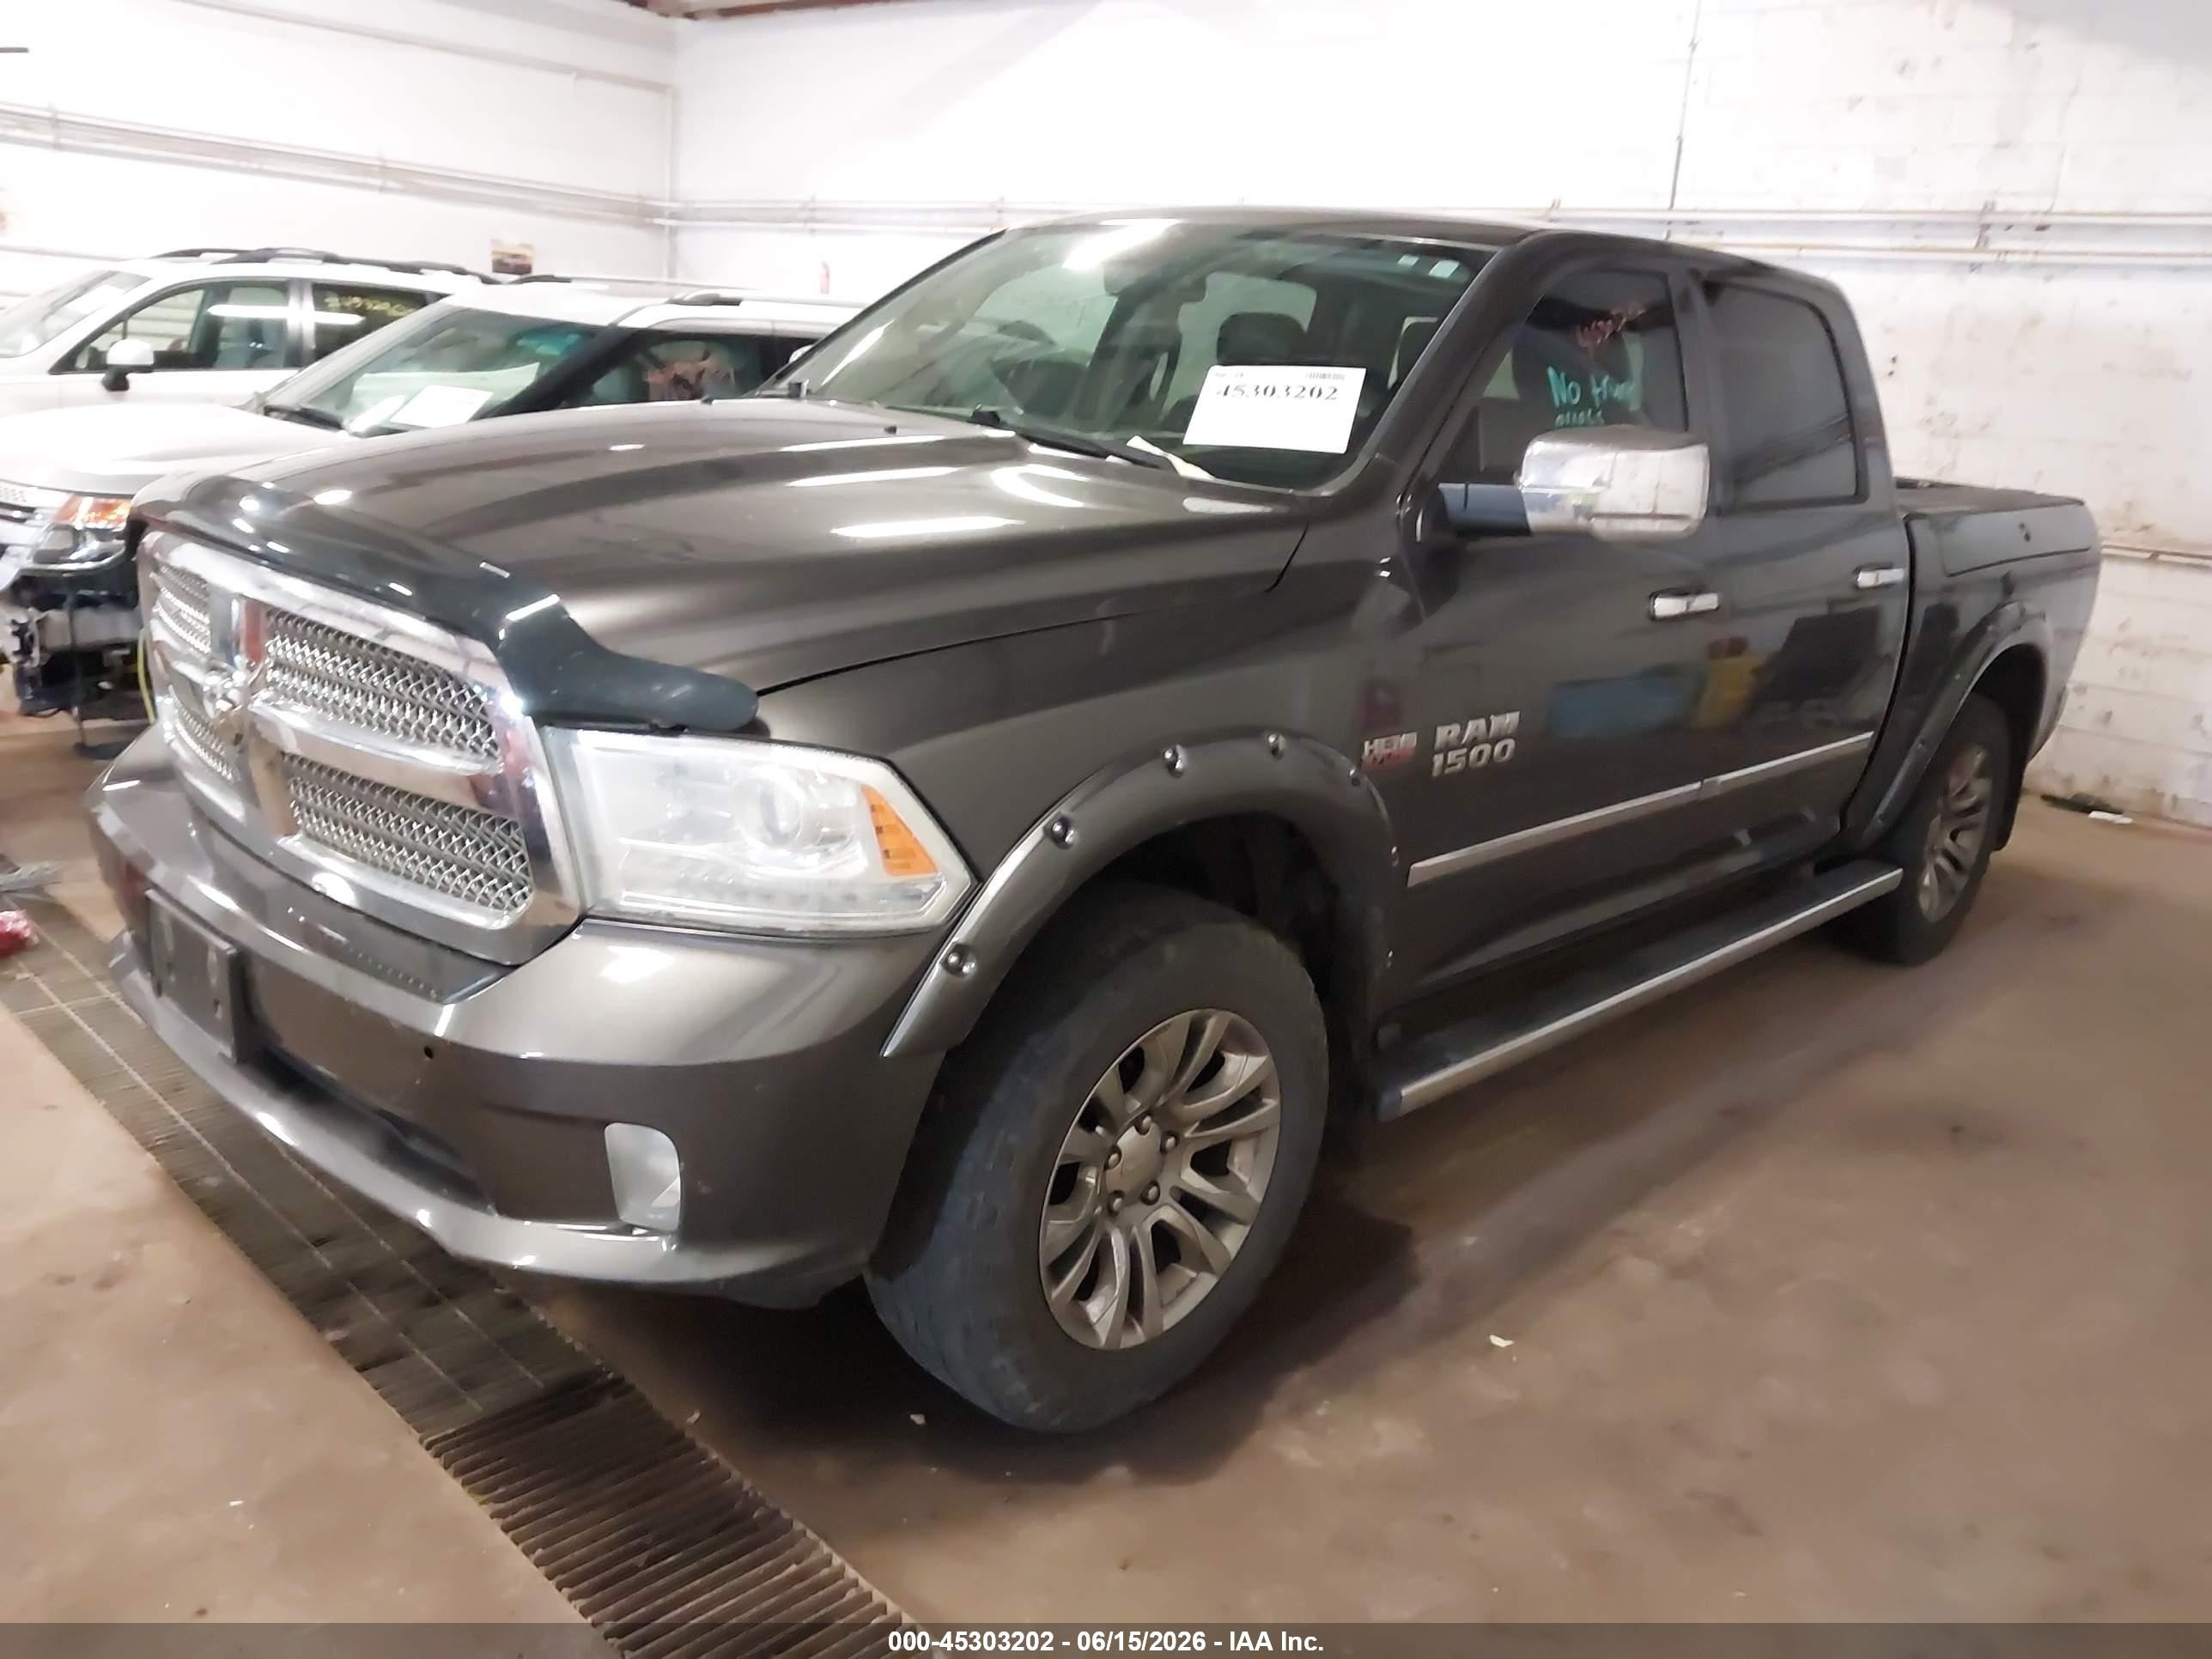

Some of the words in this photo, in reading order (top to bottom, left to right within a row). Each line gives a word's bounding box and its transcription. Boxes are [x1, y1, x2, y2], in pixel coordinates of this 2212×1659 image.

[1215, 383, 1340, 401] 45303202
[1433, 710, 1521, 751] RAM
[1431, 737, 1516, 777] 1500
